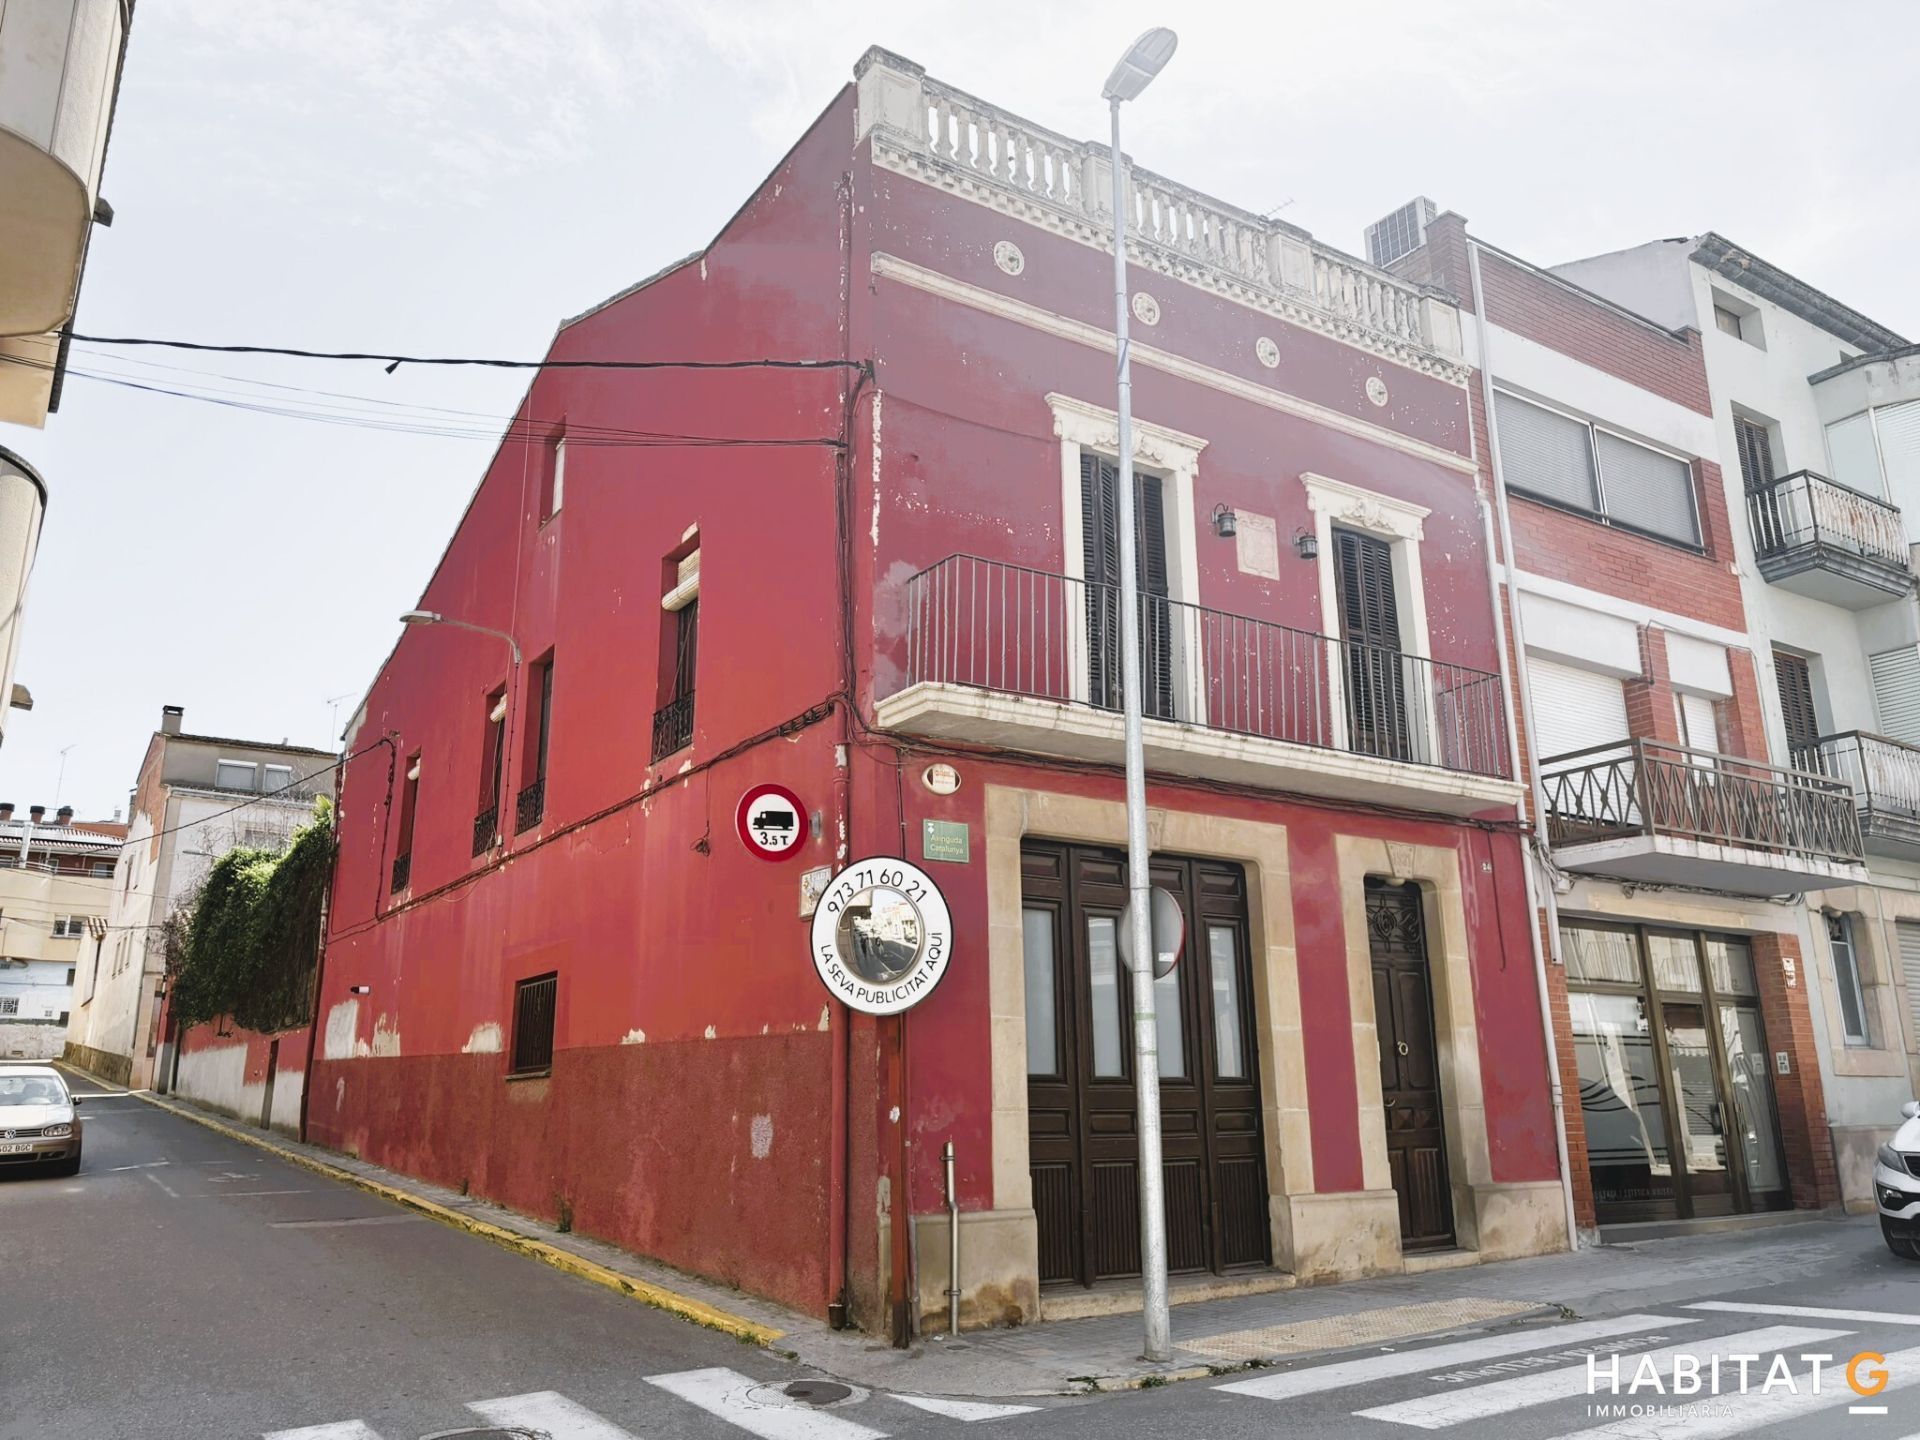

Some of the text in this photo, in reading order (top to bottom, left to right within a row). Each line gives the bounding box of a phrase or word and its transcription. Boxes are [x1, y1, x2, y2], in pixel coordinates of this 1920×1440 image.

[828, 868, 927, 913] 973 71 60 21
[821, 945, 832, 964] LA
[828, 964, 854, 996] SEVA
[856, 970, 928, 1004] PUBLICITAT
